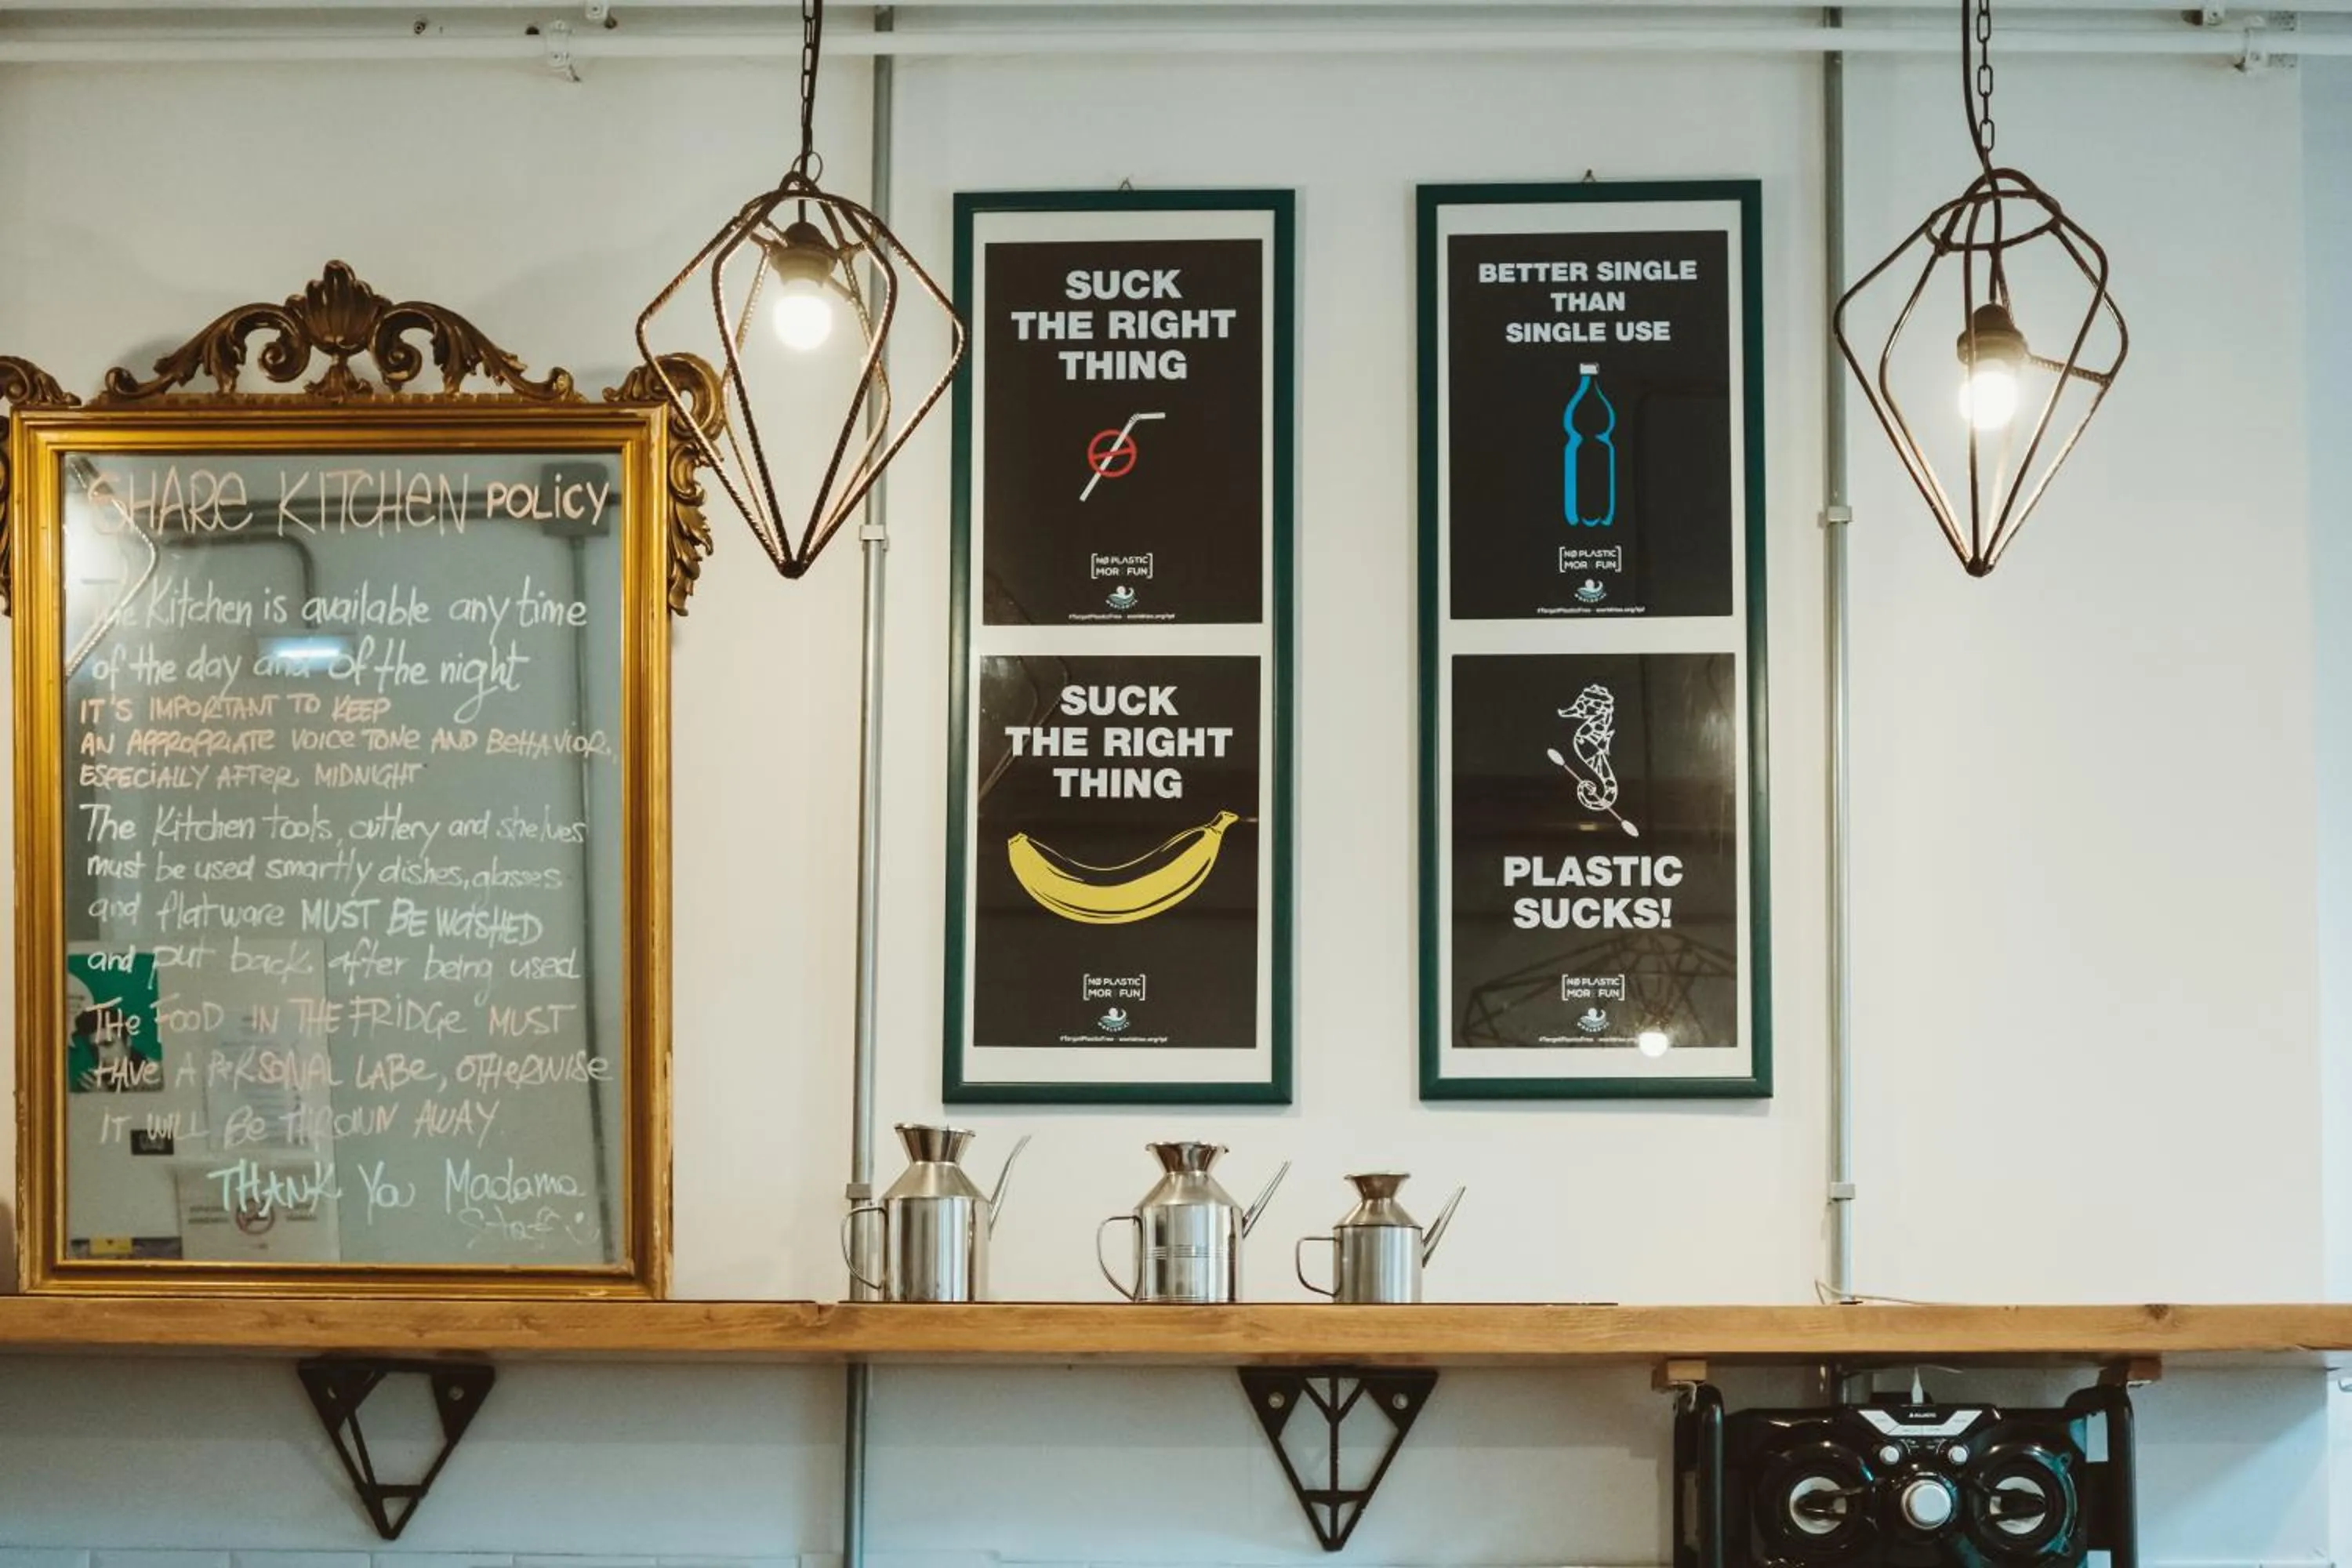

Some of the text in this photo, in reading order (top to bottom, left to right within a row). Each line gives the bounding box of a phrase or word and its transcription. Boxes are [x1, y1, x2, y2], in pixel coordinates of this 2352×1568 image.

[1065, 269, 1183, 300] SUCK
[1478, 260, 1697, 283] BETTER SINGLE
[1550, 291, 1626, 312] THAN
[1011, 309, 1237, 340] THE RIGHT
[1505, 321, 1671, 343] SINGLE USE
[1058, 350, 1189, 380] THING
[1111, 556, 1149, 564] PLASTIC
[1127, 567, 1149, 576] FUN
[1595, 561, 1617, 570] FUN
[263, 587, 289, 624] is
[301, 579, 432, 626] available
[448, 594, 510, 645] any
[517, 575, 588, 627] time
[92, 642, 126, 693] of
[129, 641, 177, 686] the
[186, 642, 242, 701] day
[374, 637, 430, 693] the
[440, 639, 531, 724] night
[80, 693, 391, 724] IT'S IMPORTANT TO KEEP
[1060, 684, 1179, 716] SUCK
[80, 731, 116, 757] AN
[431, 728, 478, 753] AND
[1004, 727, 1233, 757] THE RIGHT
[314, 762, 424, 789] MIDNIGHT
[1053, 768, 1183, 799] THING
[79, 804, 136, 842] The
[349, 800, 441, 859] cutlery
[448, 808, 491, 840] and
[495, 804, 587, 843] shelves
[86, 851, 147, 879] must
[155, 850, 187, 882] be
[194, 854, 256, 882] used
[264, 847, 373, 897] smartly
[1503, 855, 1683, 887] PLASTIC
[88, 891, 142, 927] and
[156, 889, 285, 932] flatware
[300, 898, 381, 933] MUST
[386, 898, 429, 938] BE
[1512, 897, 1672, 929] SUCKS!
[87, 945, 136, 973] and
[147, 938, 216, 990] put
[328, 937, 409, 985] after
[424, 942, 493, 1007] being
[509, 947, 581, 980] used
[1103, 977, 1142, 986] PLASTIC
[1581, 977, 1621, 986] PLASTIC
[1119, 988, 1141, 998] FUN
[1598, 988, 1620, 998] FUN
[149, 993, 224, 1044] FOOD
[252, 1004, 280, 1033] IN
[287, 997, 344, 1039] THE
[488, 1004, 578, 1036] MUST
[176, 1051, 196, 1088] A
[100, 1107, 132, 1144] IT
[147, 1109, 209, 1141] WILL
[206, 1157, 343, 1217] THANK
[358, 1160, 416, 1226] You
